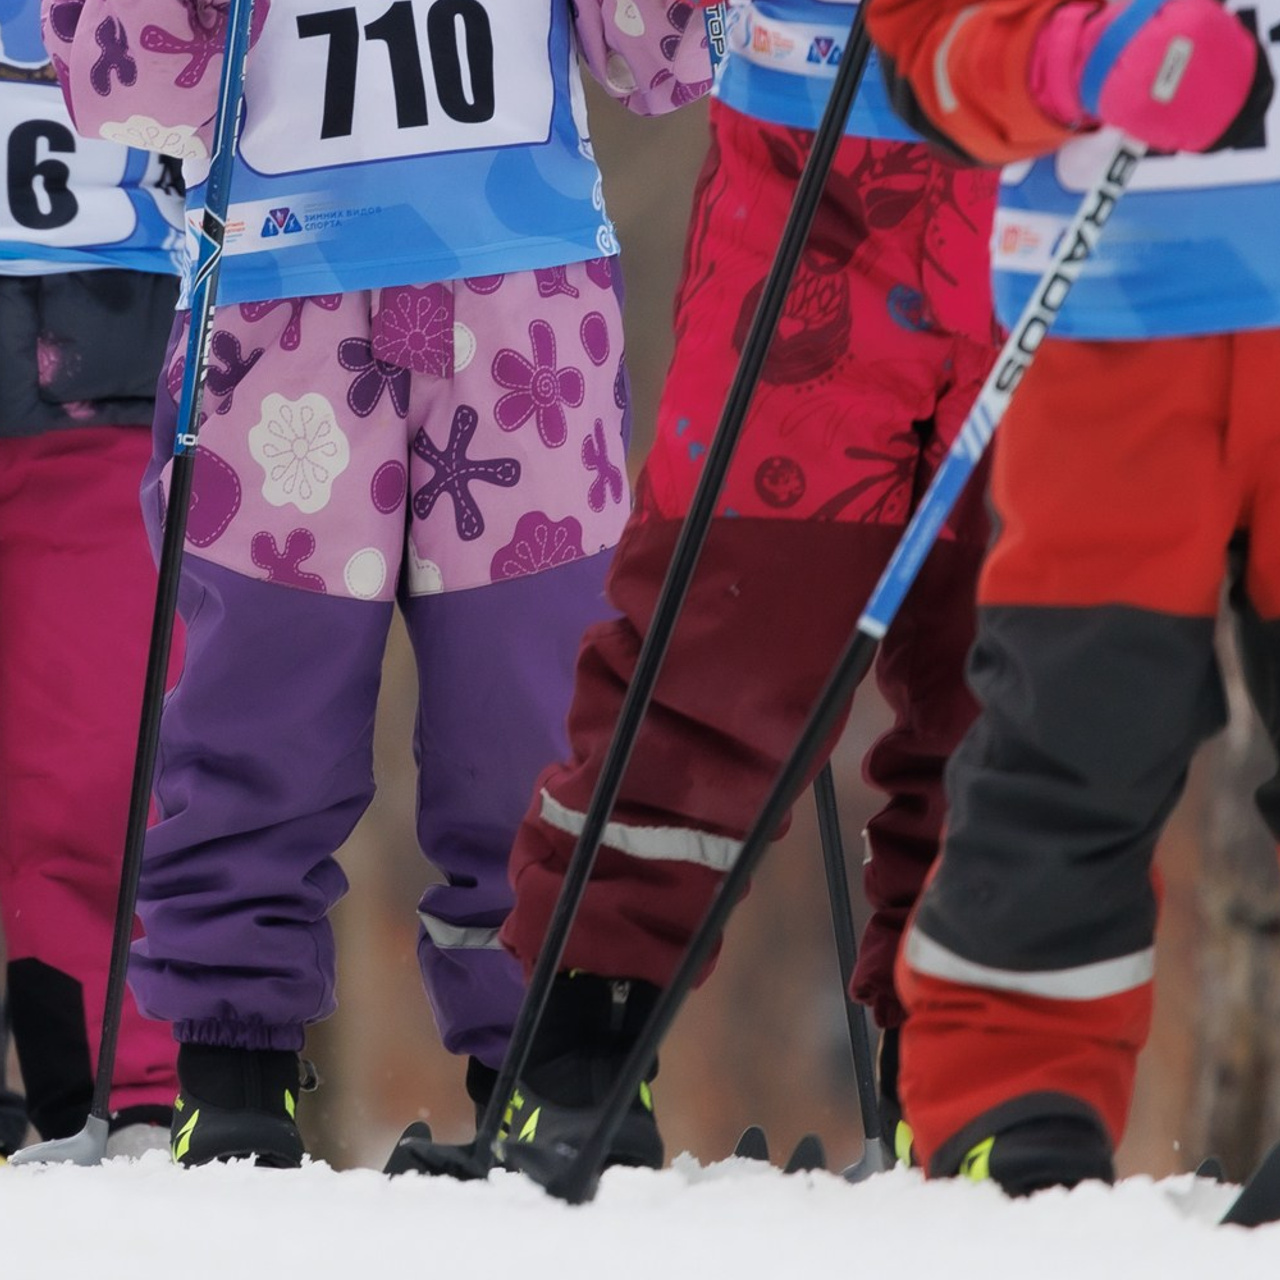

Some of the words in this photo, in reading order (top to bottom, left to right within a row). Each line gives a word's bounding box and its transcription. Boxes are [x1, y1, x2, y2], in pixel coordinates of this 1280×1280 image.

[304, 220, 342, 231] СПОРТА
[995, 147, 1139, 393] BRADOS
[177, 432, 199, 447] 10
